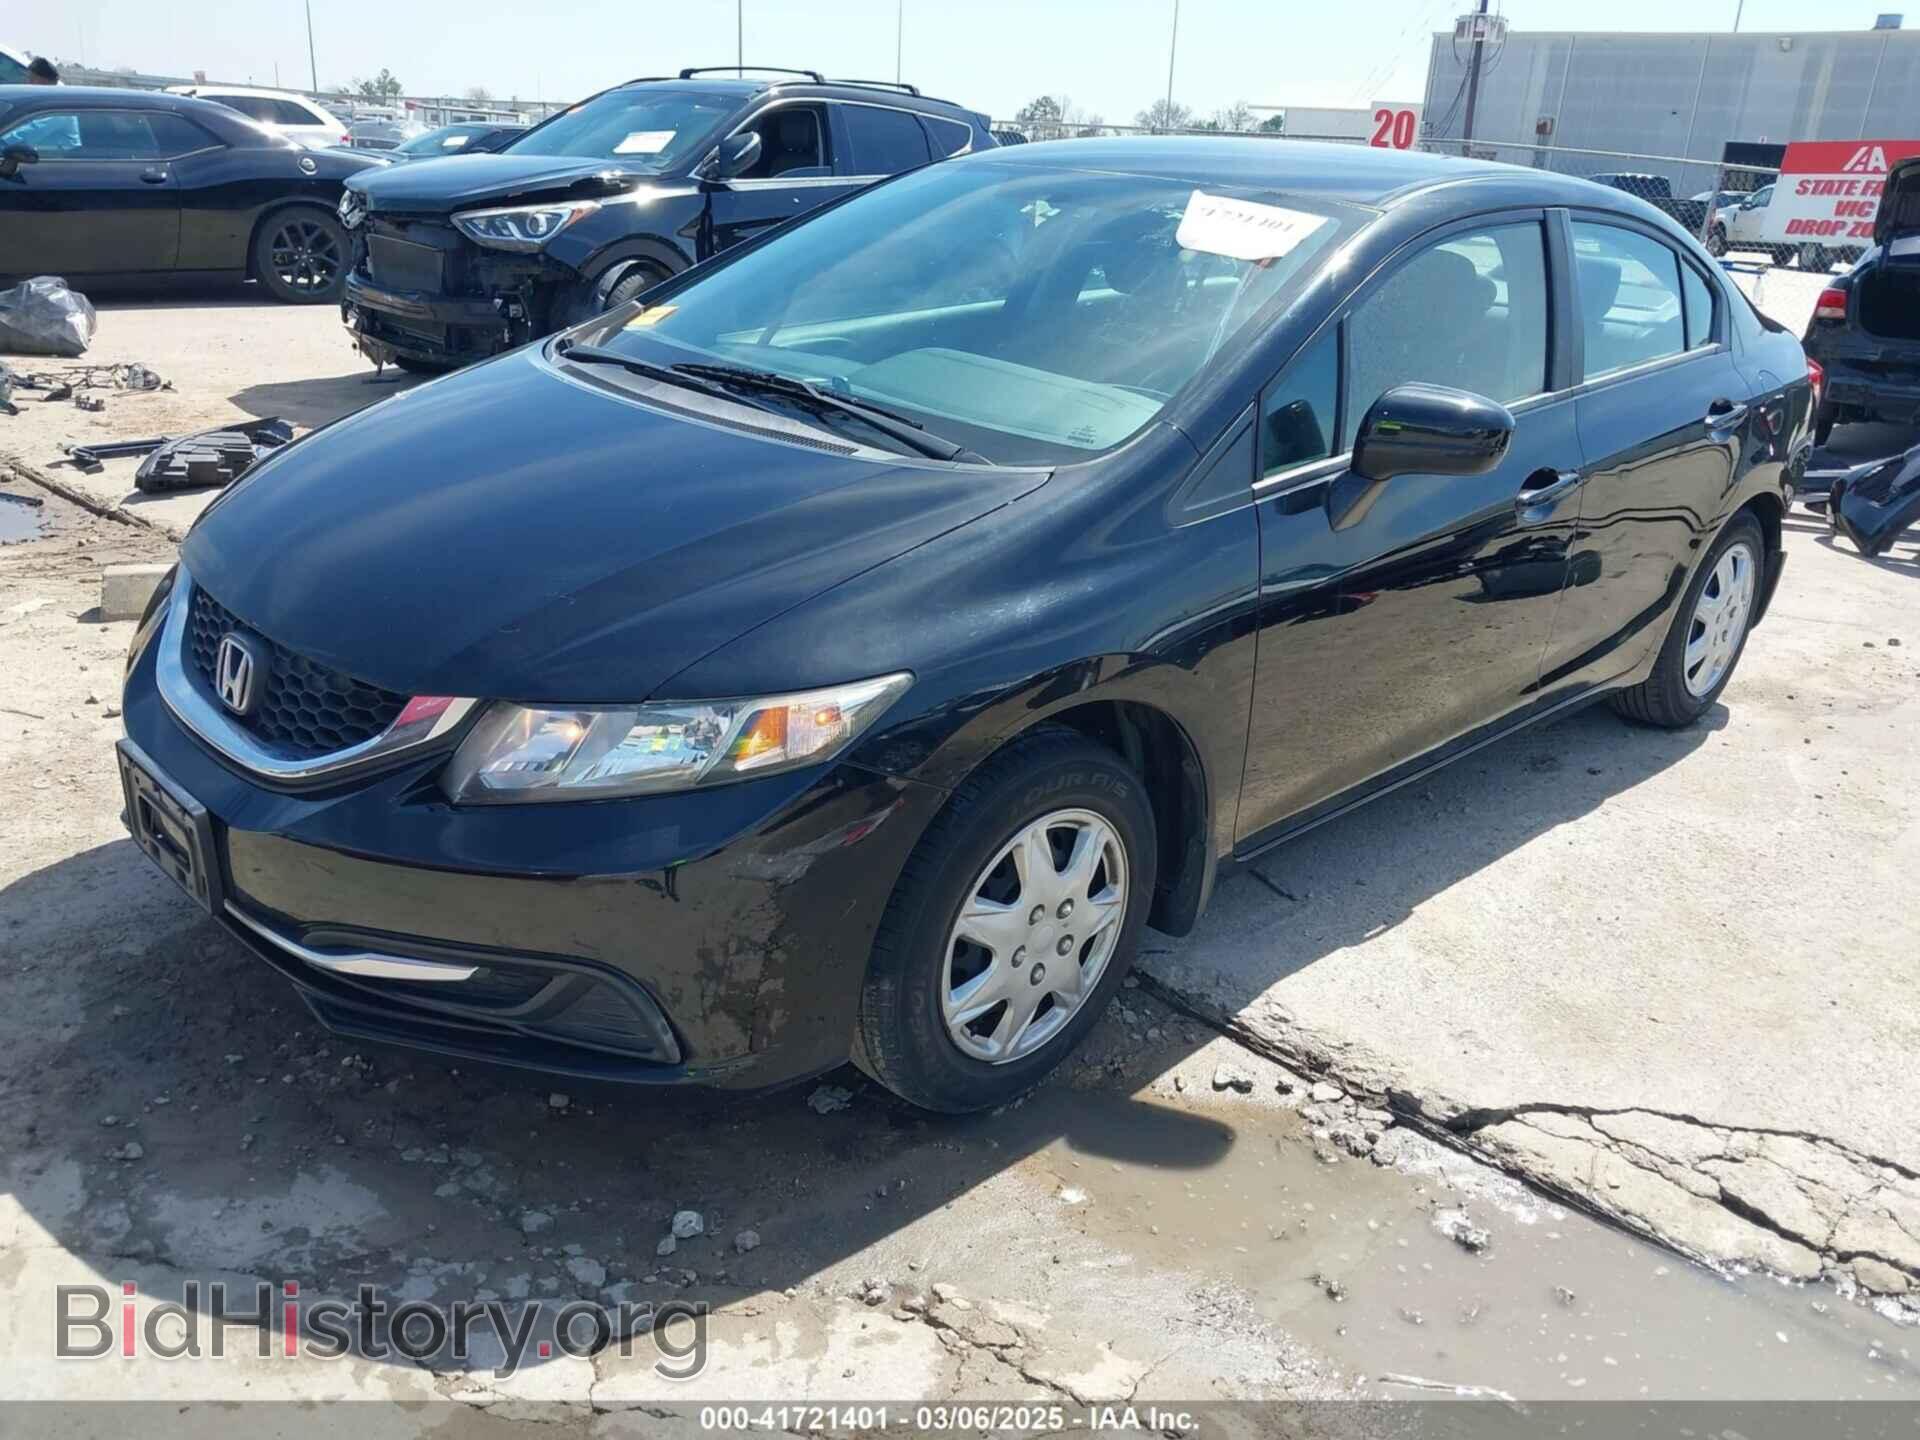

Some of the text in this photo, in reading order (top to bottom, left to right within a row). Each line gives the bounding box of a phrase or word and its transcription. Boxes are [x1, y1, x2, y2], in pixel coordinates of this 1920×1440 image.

[1371, 109, 1415, 149] 20
[1795, 179, 1859, 196] STATE
[1834, 200, 1876, 217] VIC
[1785, 219, 1844, 236] DROP
